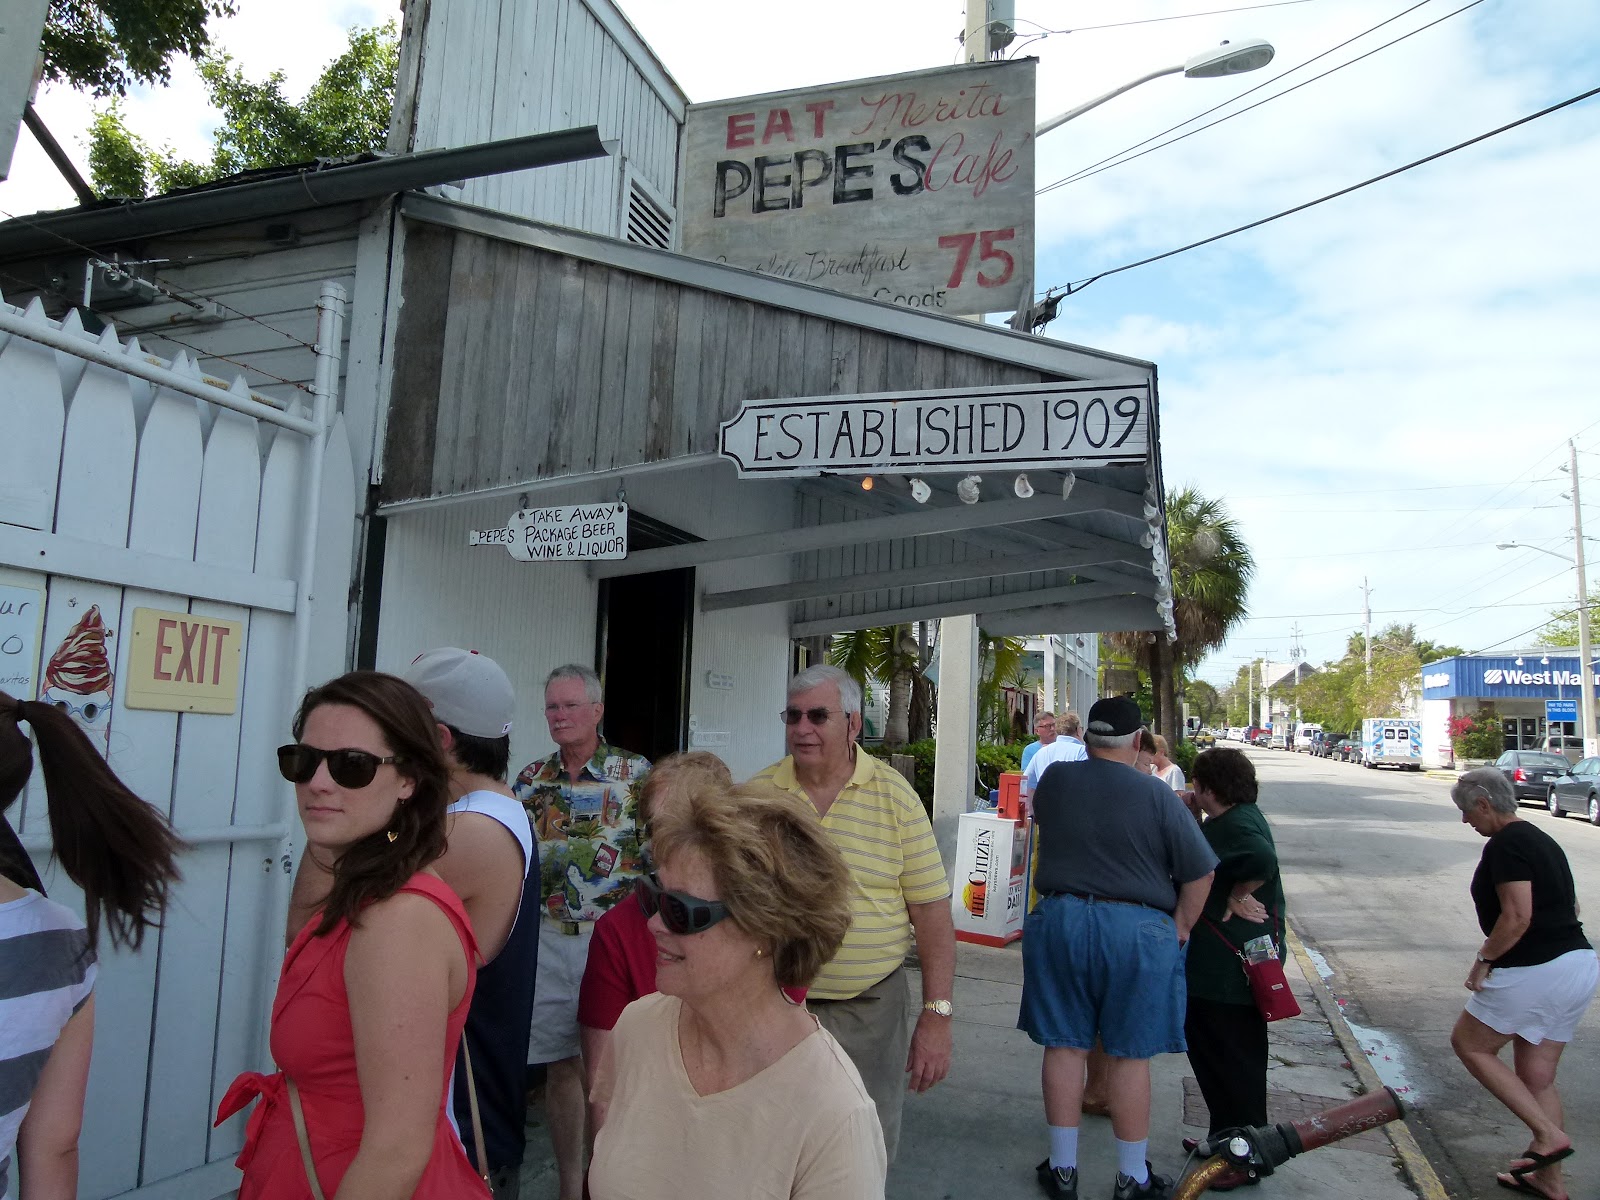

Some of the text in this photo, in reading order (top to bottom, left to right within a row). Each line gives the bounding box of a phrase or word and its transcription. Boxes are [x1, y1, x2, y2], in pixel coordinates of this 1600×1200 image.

[726, 101, 834, 150] EAT
[853, 80, 1009, 136] Merita
[713, 135, 931, 218] PEPE'S
[805, 243, 911, 286] Breakfast
[938, 228, 1015, 289] 75
[754, 396, 1141, 462] ESTABLISHED 1909
[478, 526, 515, 543] PEPE'S
[525, 522, 615, 543] PACKAGE BEER
[530, 505, 615, 524] TAKE AWAY
[526, 536, 624, 559] WINE & LIQUOR
[153, 618, 230, 686] EXIT
[1503, 669, 1600, 685] West Main
[968, 828, 991, 920] THE CITIZEN
